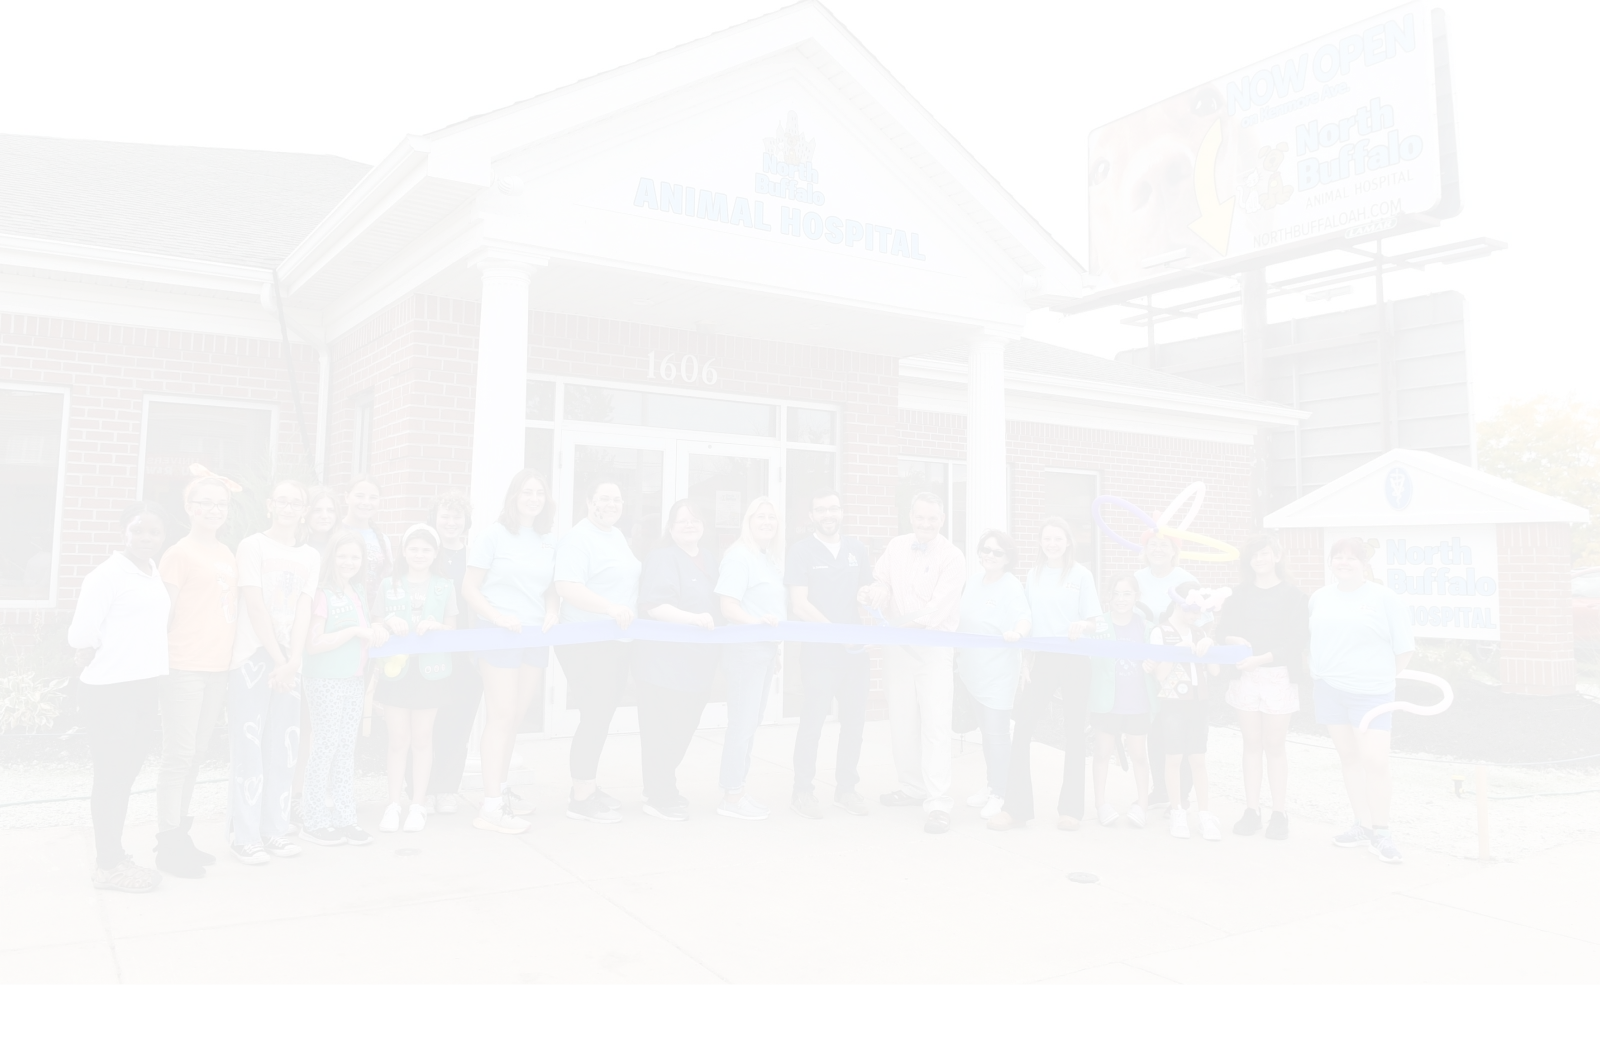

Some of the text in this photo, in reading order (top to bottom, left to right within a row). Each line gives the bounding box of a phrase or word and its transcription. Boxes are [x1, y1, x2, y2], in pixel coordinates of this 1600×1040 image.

[1226, 12, 1416, 117] NOW OPEN
[1241, 81, 1351, 129] on Kenmore Ave.
[1296, 97, 1394, 157] North
[762, 152, 819, 184] North
[1297, 129, 1424, 192] Buffalo
[755, 172, 825, 206] Buffalo
[1305, 169, 1414, 209] ANIMAL HOSPITAL
[633, 177, 926, 261] ANIMAL HOSPITAL
[1253, 198, 1402, 249] NORTHBUFFALOAH.COM
[1348, 219, 1393, 237] LAMAR
[646, 350, 718, 385] 1606
[1386, 536, 1472, 566] North
[1387, 567, 1497, 597] Buffalo
